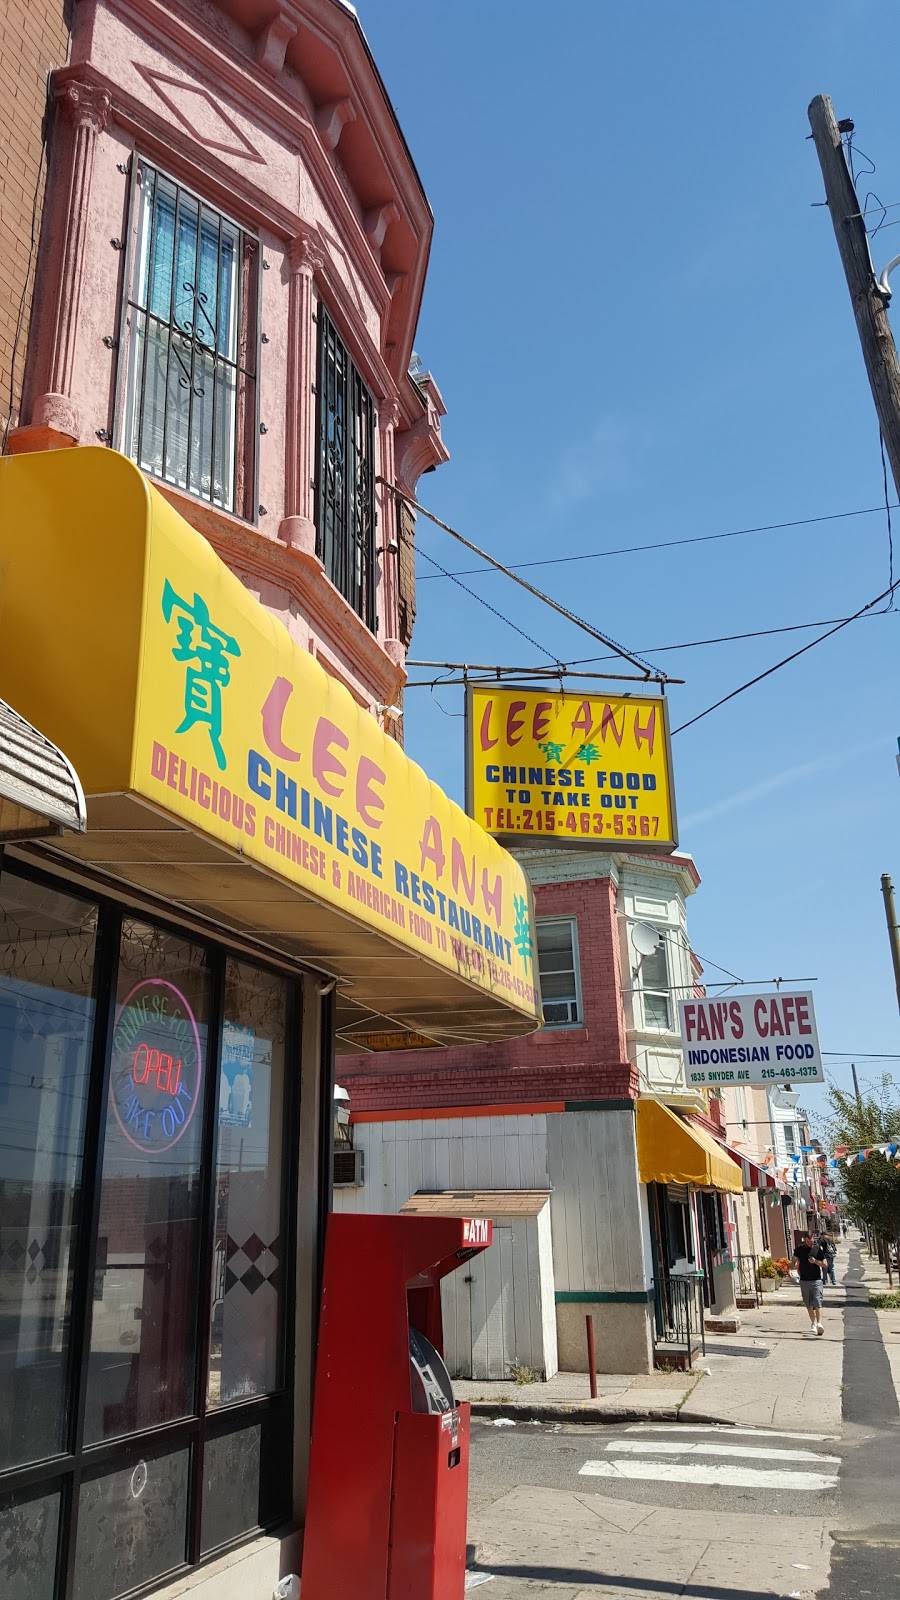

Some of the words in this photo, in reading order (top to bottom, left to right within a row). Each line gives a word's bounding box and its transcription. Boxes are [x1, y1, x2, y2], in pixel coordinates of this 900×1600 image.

[480, 700, 553, 752] LEE
[571, 700, 656, 759] ANH
[485, 765, 585, 788] CHINESE
[597, 771, 657, 791] FOOD
[506, 789, 531, 804] TO
[541, 791, 590, 807] TAKE
[601, 794, 639, 810] OUT
[261, 675, 386, 829] LEE
[418, 813, 502, 928] ANH
[484, 807, 659, 837] TEL:215-463-5367
[151, 740, 257, 838] DELICIOUS
[264, 815, 326, 881] CHINESE
[332, 859, 342, 890] &
[347, 869, 406, 929] AMERICAN
[408, 909, 433, 945] FOOD
[436, 926, 448, 953] TO
[248, 748, 383, 880] CHINESE
[394, 859, 512, 966] RESTAURANT
[683, 1000, 744, 1042] FAN'S
[753, 996, 812, 1038] CAFE
[133, 1042, 183, 1096] OPEN
[688, 1046, 770, 1065] INDONESIAN
[776, 1043, 814, 1061] FOOD
[690, 1072, 706, 1082] 1835
[708, 1070, 735, 1081] SNYDER
[737, 1069, 750, 1080] AVE
[761, 1066, 818, 1079] 215-463-1375
[162, 1082, 193, 1138] OUT
[468, 1219, 488, 1243] ATM
